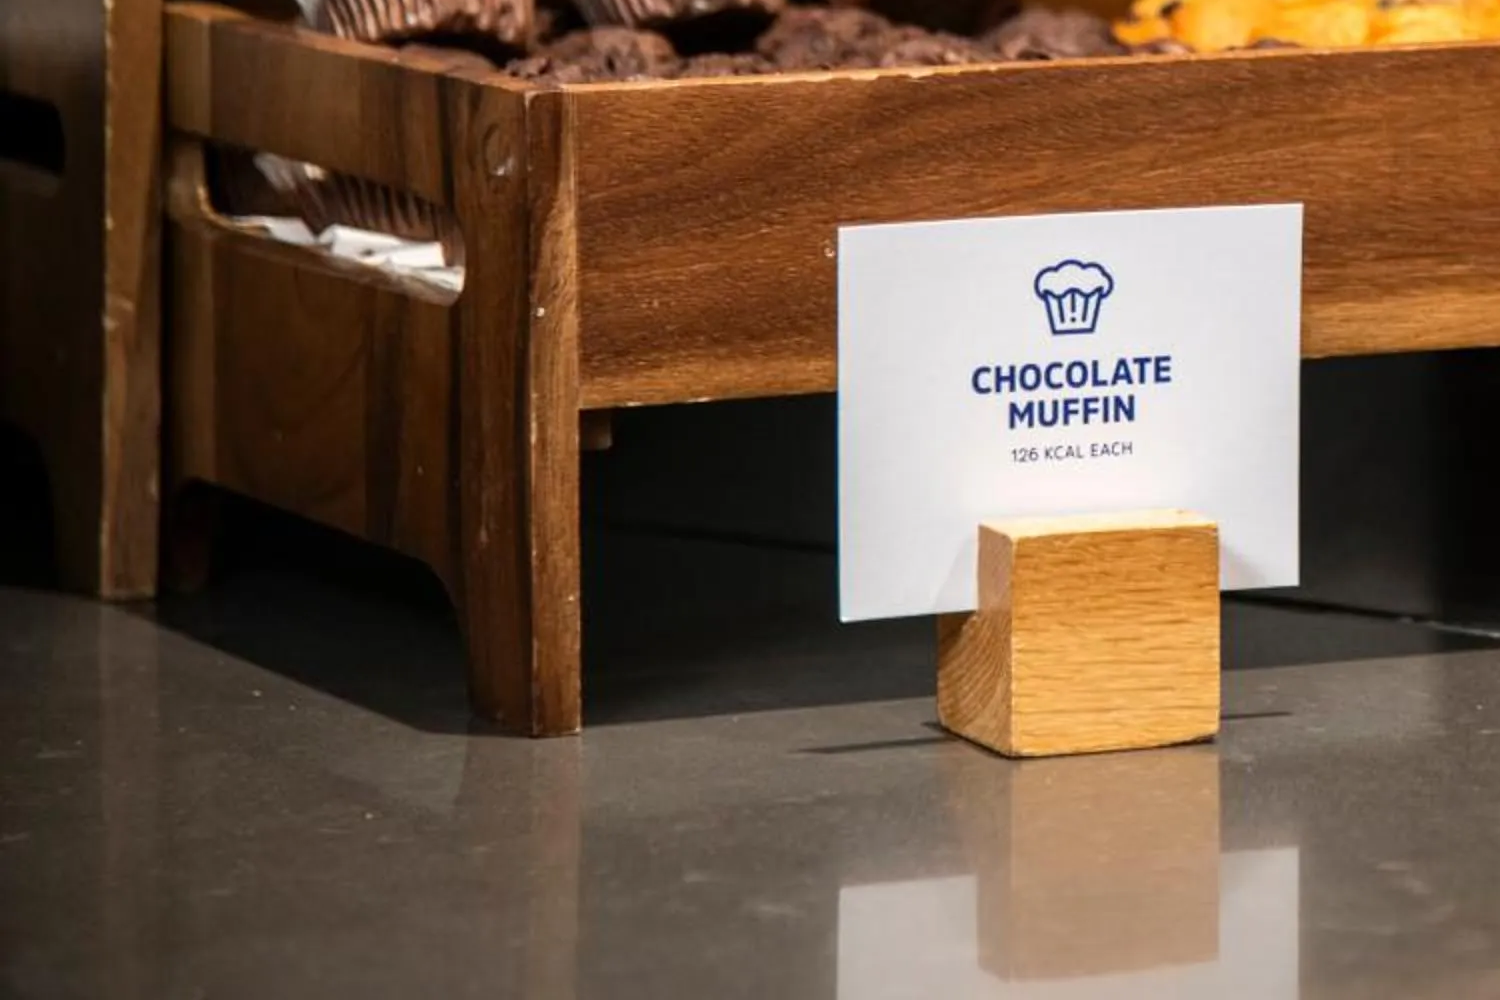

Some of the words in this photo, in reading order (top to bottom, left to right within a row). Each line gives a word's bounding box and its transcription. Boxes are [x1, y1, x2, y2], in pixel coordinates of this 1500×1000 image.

[971, 355, 1172, 394] CHOCOLATE
[1008, 394, 1136, 430] MUFFIN
[1011, 448, 1039, 462] 126
[1044, 446, 1084, 460] KCAL
[1090, 442, 1133, 457] EACH
